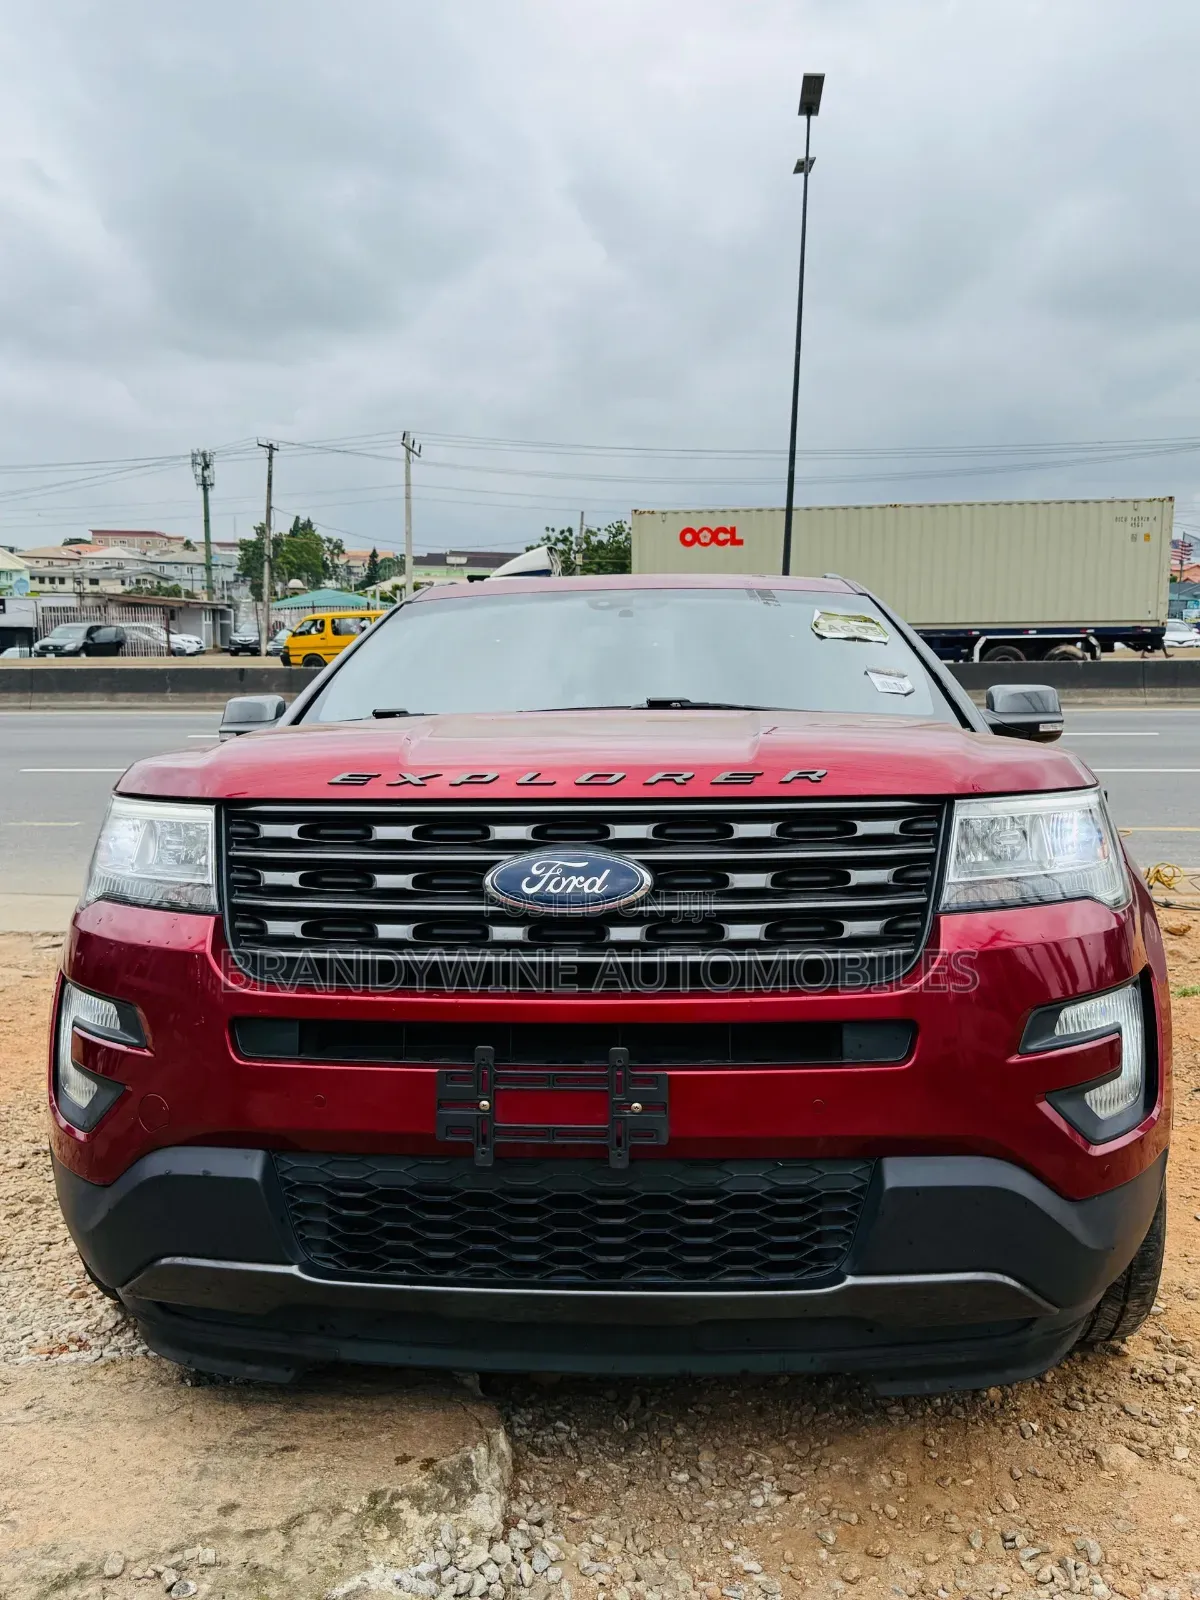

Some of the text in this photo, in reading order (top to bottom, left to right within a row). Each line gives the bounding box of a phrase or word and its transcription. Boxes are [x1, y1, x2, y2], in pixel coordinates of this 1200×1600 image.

[679, 526, 744, 547] OOCL
[327, 769, 828, 787] EXPLORER
[521, 860, 611, 894] Ford
